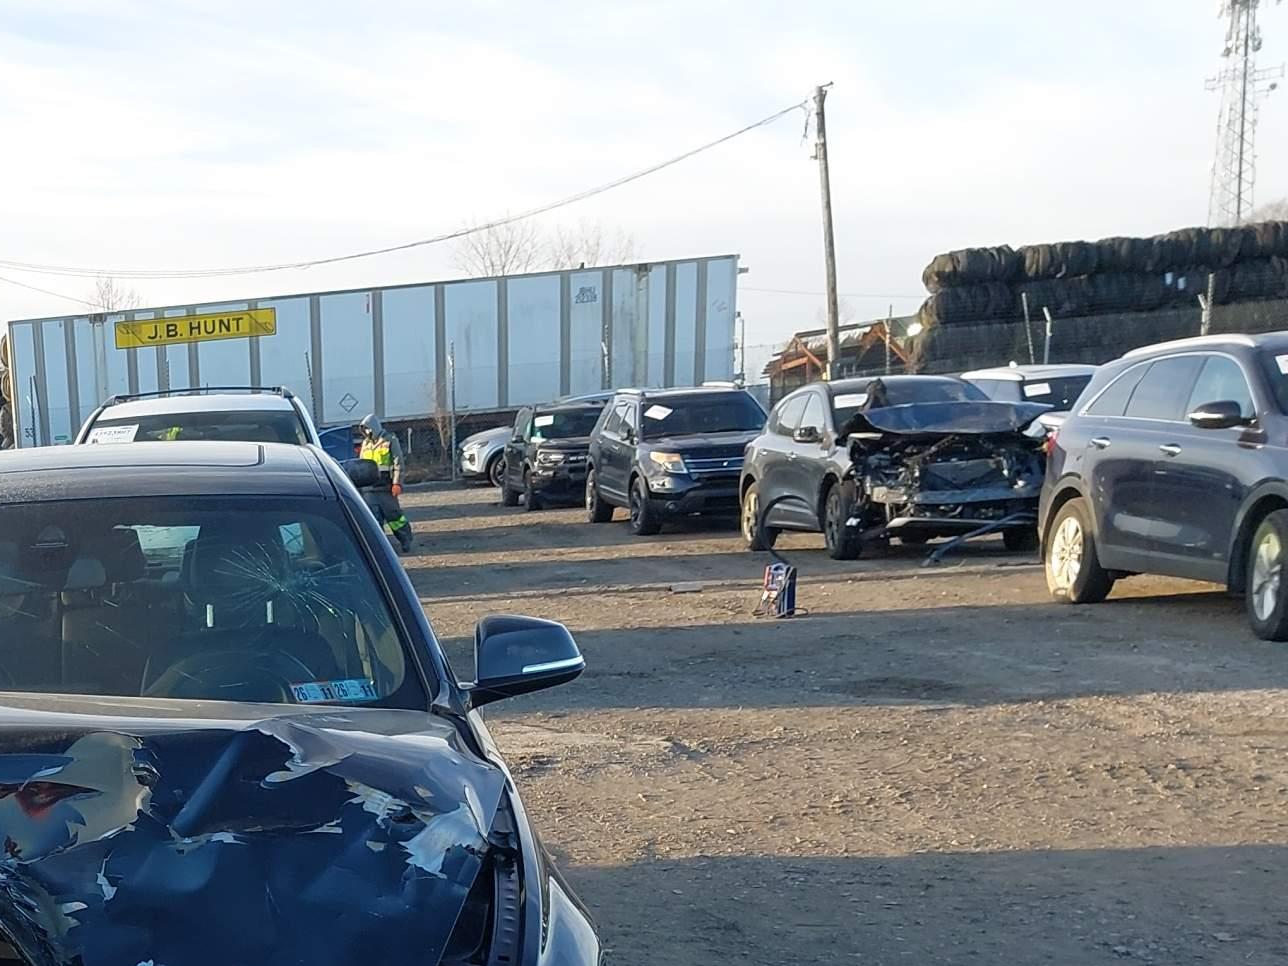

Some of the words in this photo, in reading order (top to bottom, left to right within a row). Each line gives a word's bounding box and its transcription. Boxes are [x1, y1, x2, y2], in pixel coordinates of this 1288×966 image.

[147, 323, 183, 340] J.B.
[189, 317, 244, 336] HUNT
[294, 686, 308, 701] 26
[321, 687, 334, 700] 11
[335, 683, 349, 698] 26
[361, 684, 374, 697] 11
